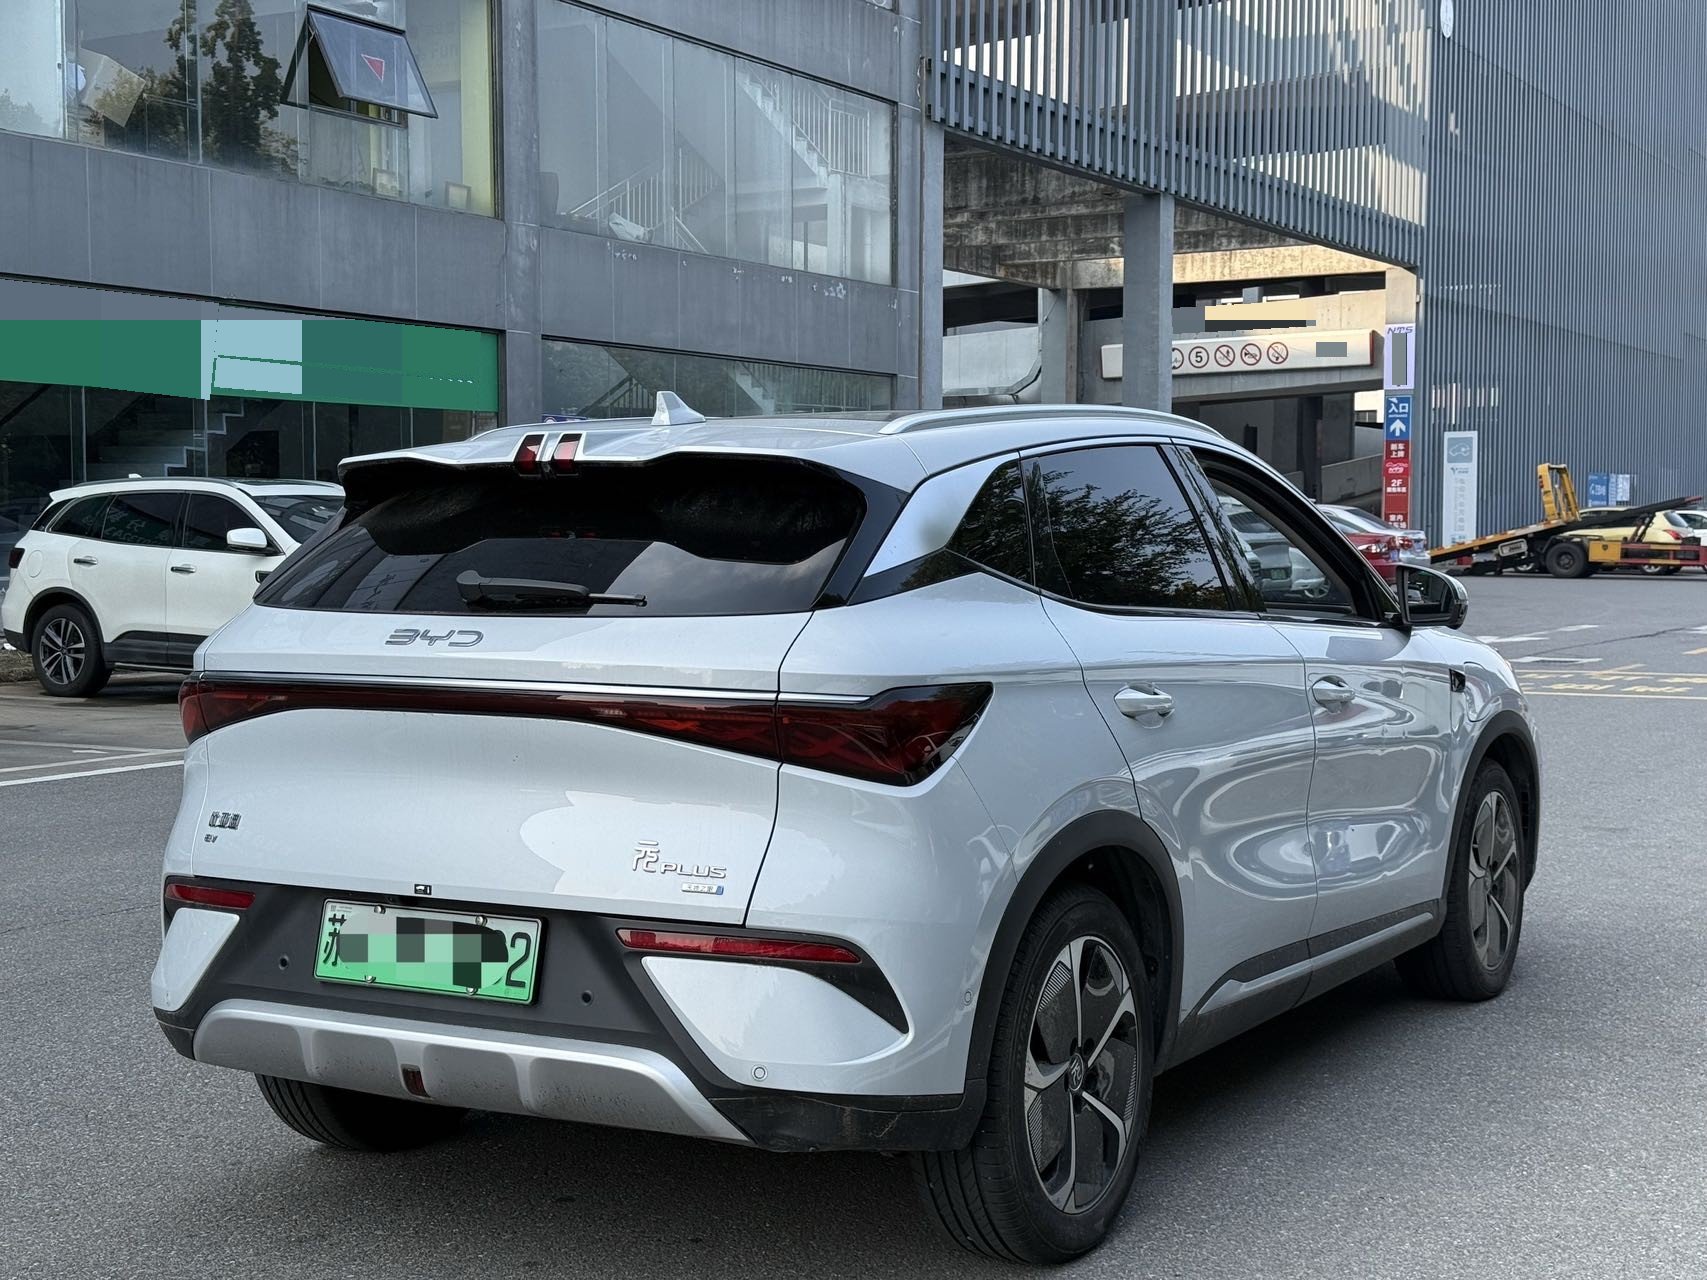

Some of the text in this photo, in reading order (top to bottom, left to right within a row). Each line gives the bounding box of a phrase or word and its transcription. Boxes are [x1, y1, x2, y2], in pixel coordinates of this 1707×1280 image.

[1195, 351, 1203, 364] 5
[1388, 402, 1409, 413] 入口
[1391, 479, 1403, 487] 2F
[384, 628, 485, 648] BYD
[660, 861, 728, 880] PLUS
